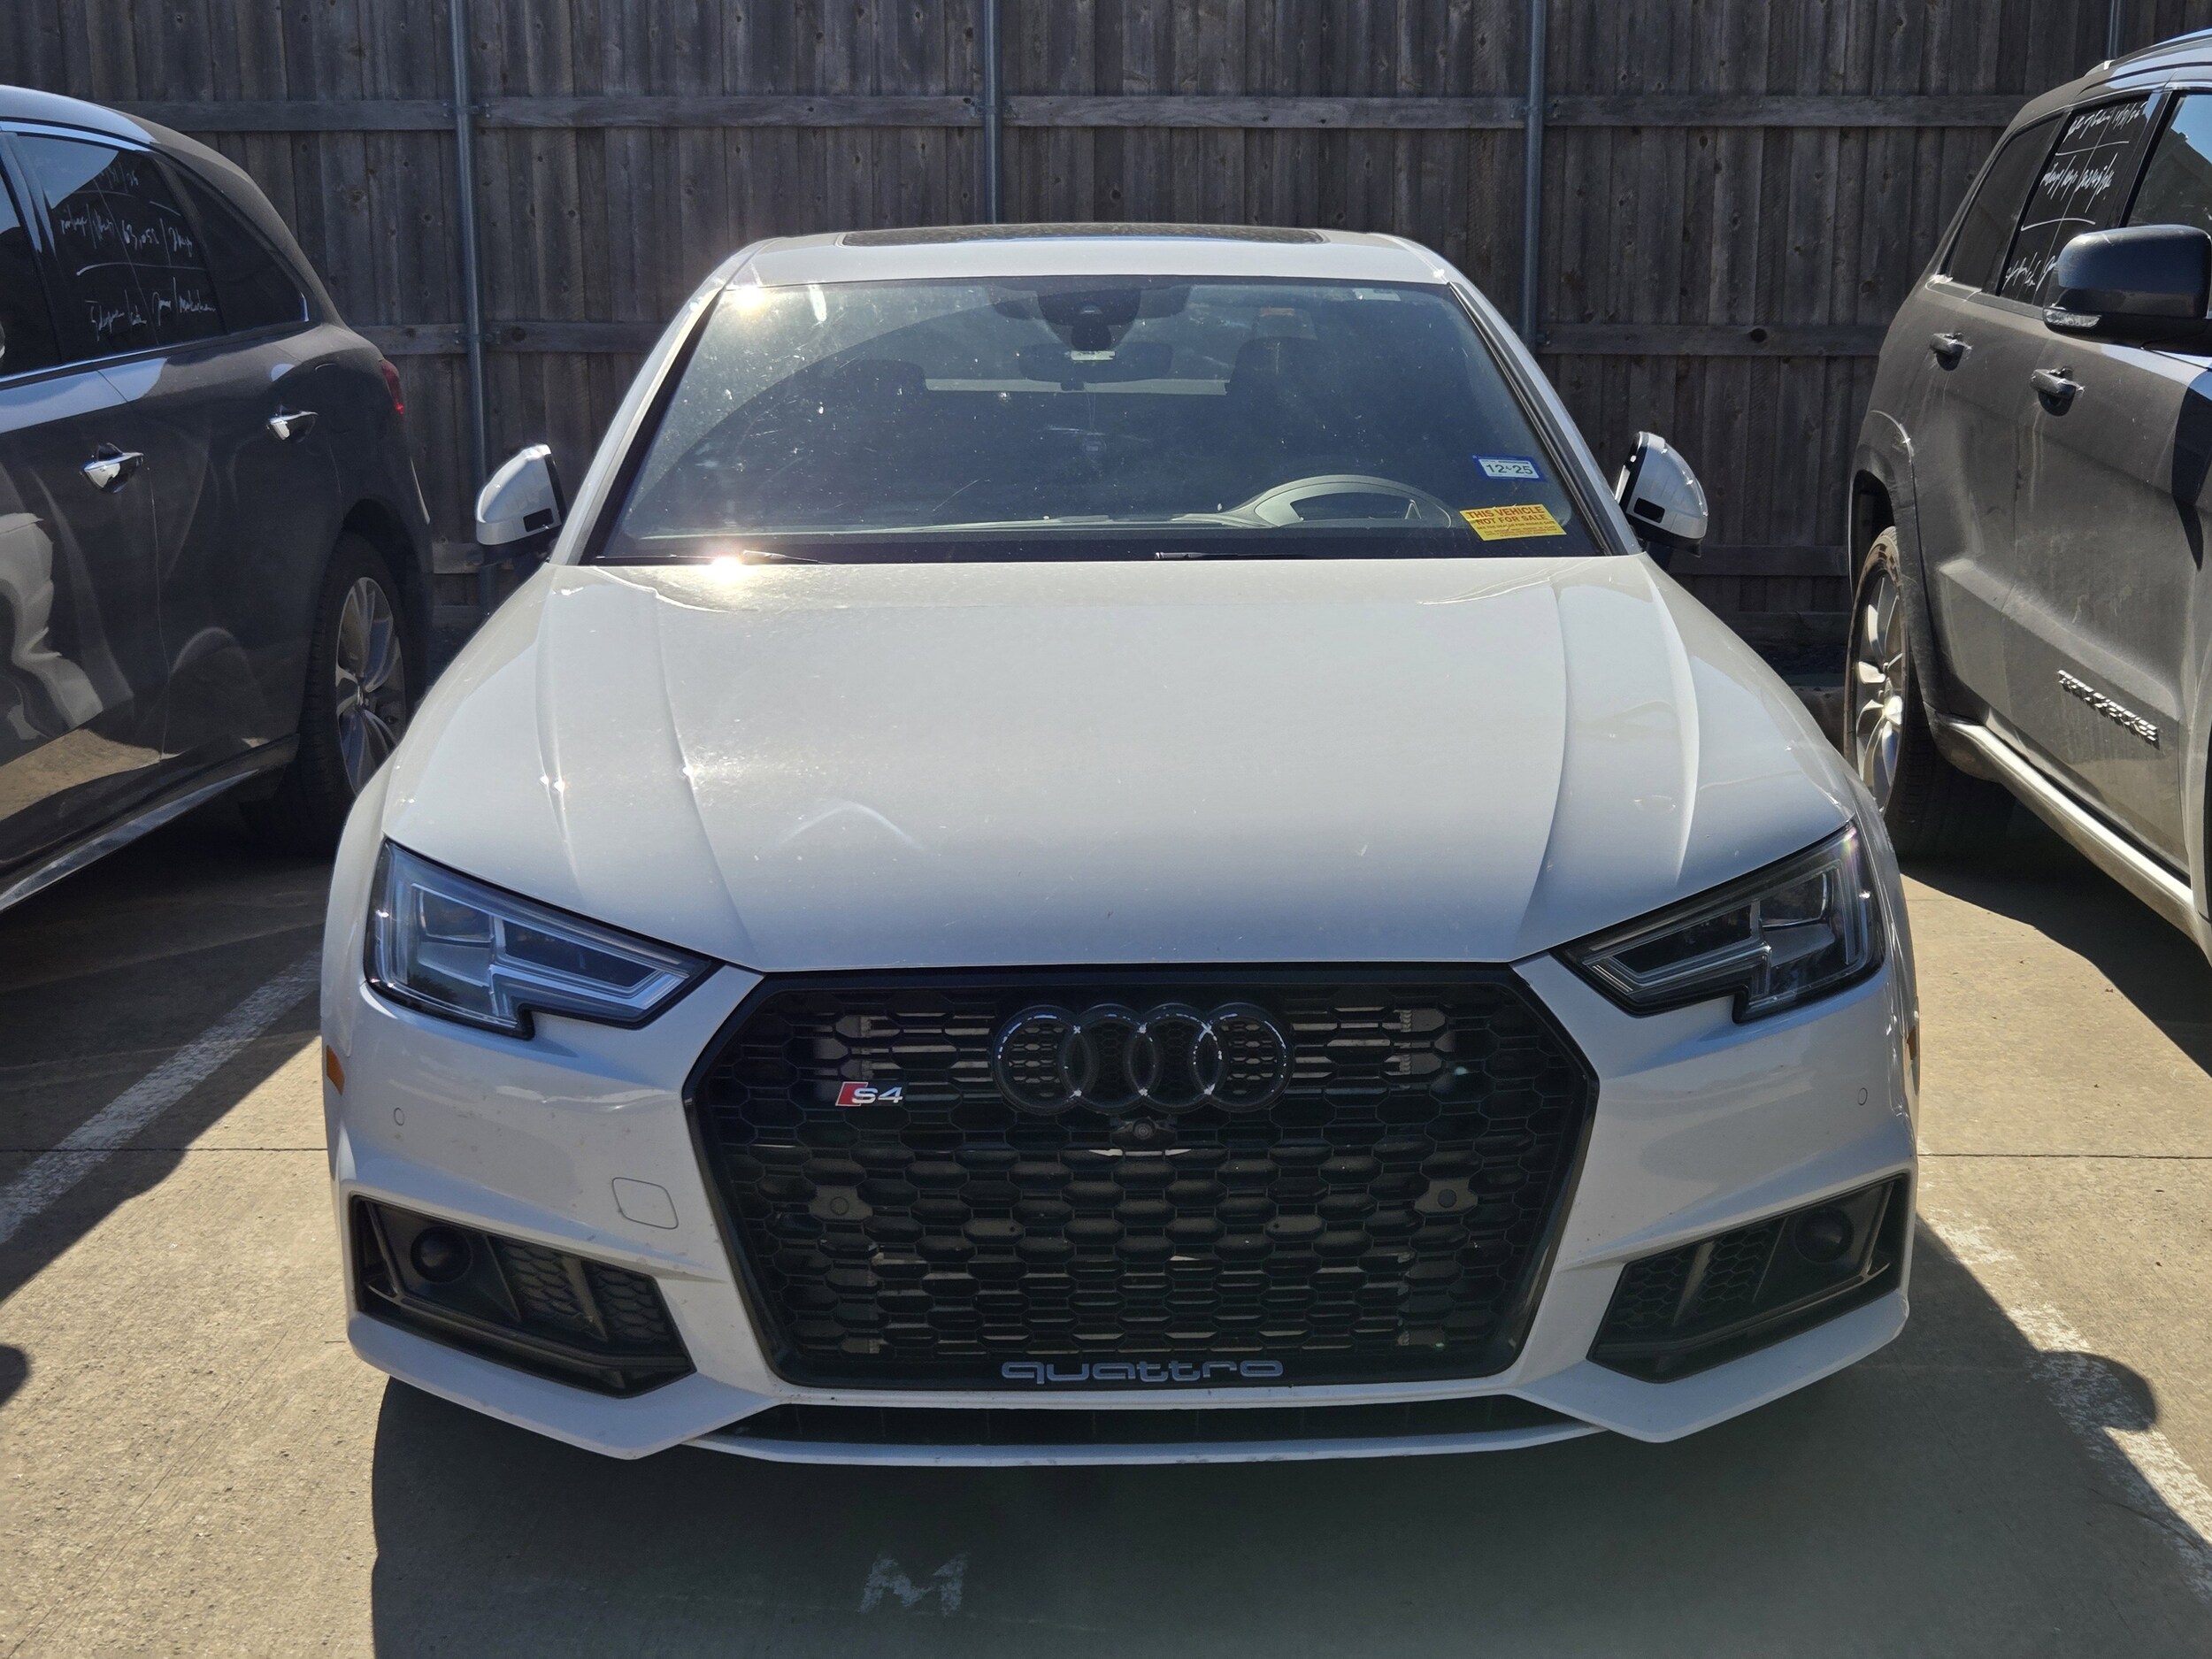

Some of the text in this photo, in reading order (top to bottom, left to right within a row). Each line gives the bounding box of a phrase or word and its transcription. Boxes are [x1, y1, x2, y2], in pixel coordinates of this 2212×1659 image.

[1465, 506, 1545, 519] THIS VEHICLE
[851, 1087, 903, 1104] S4
[1001, 1359, 1284, 1385] quattro
